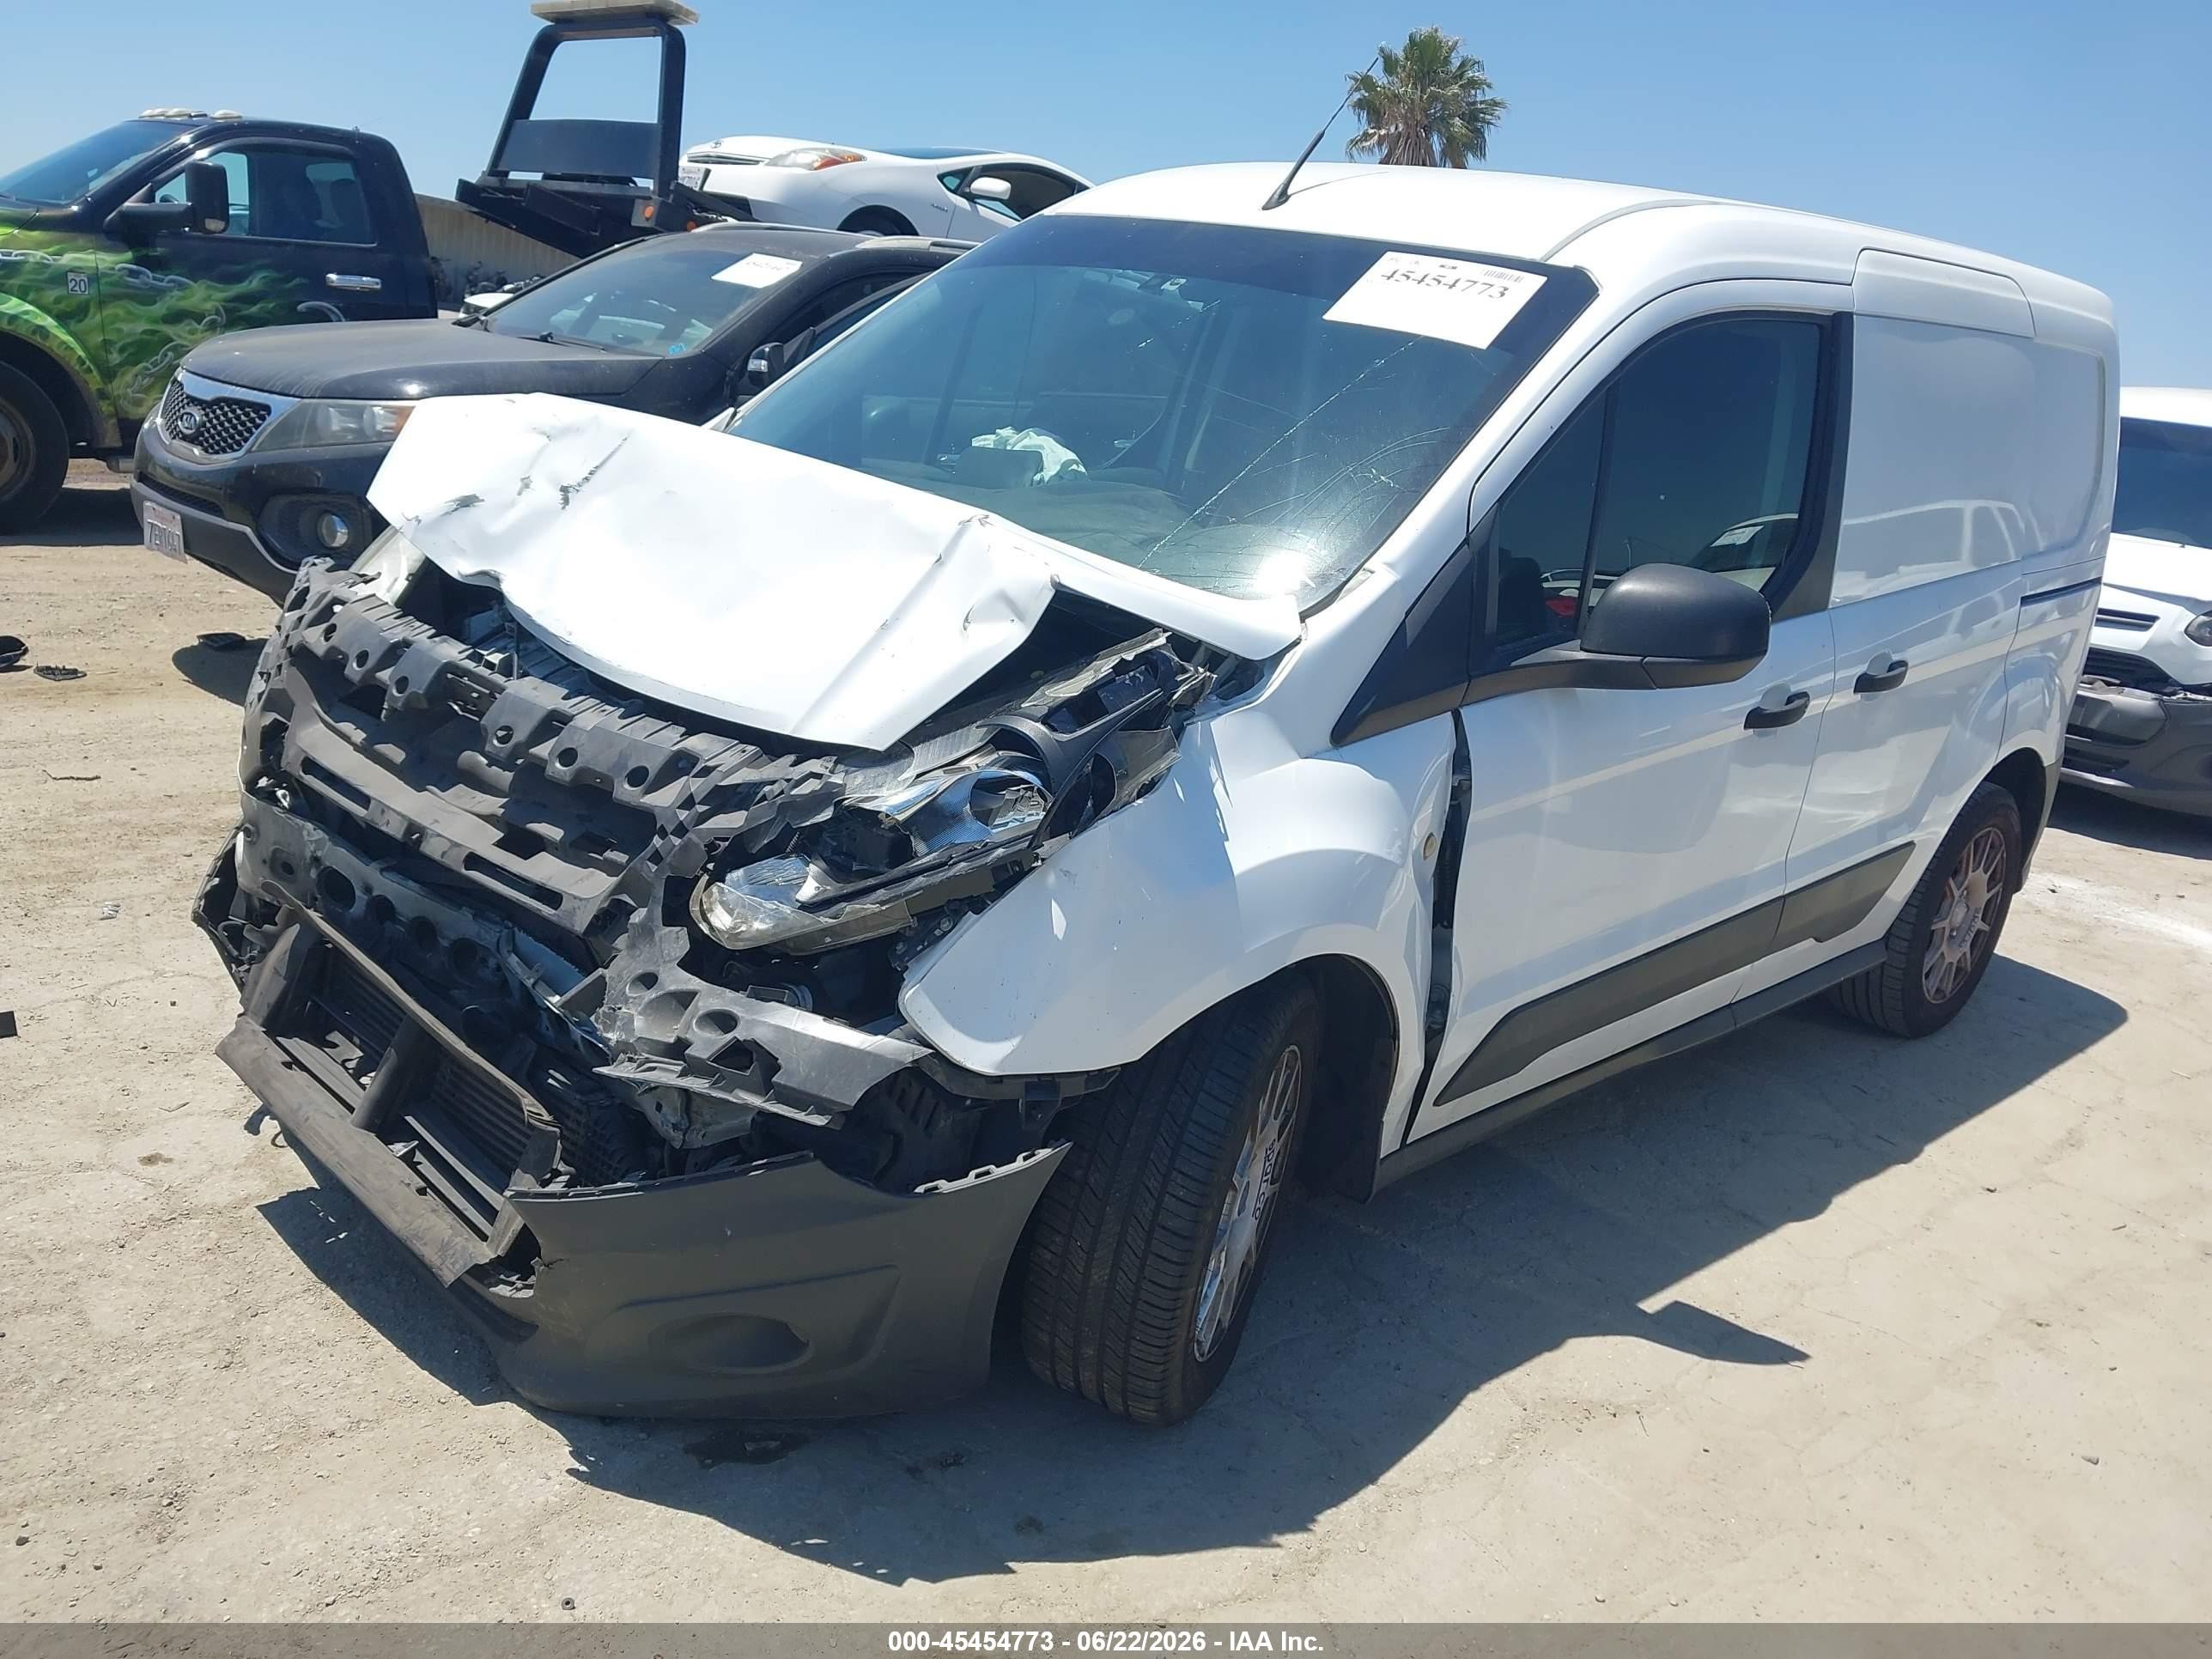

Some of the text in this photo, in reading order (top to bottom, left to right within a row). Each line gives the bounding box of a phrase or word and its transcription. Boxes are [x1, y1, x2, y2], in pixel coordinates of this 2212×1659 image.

[70, 278, 87, 293] 20
[1381, 268, 1510, 299] 45454773
[1255, 1139, 1276, 1220] sparco
